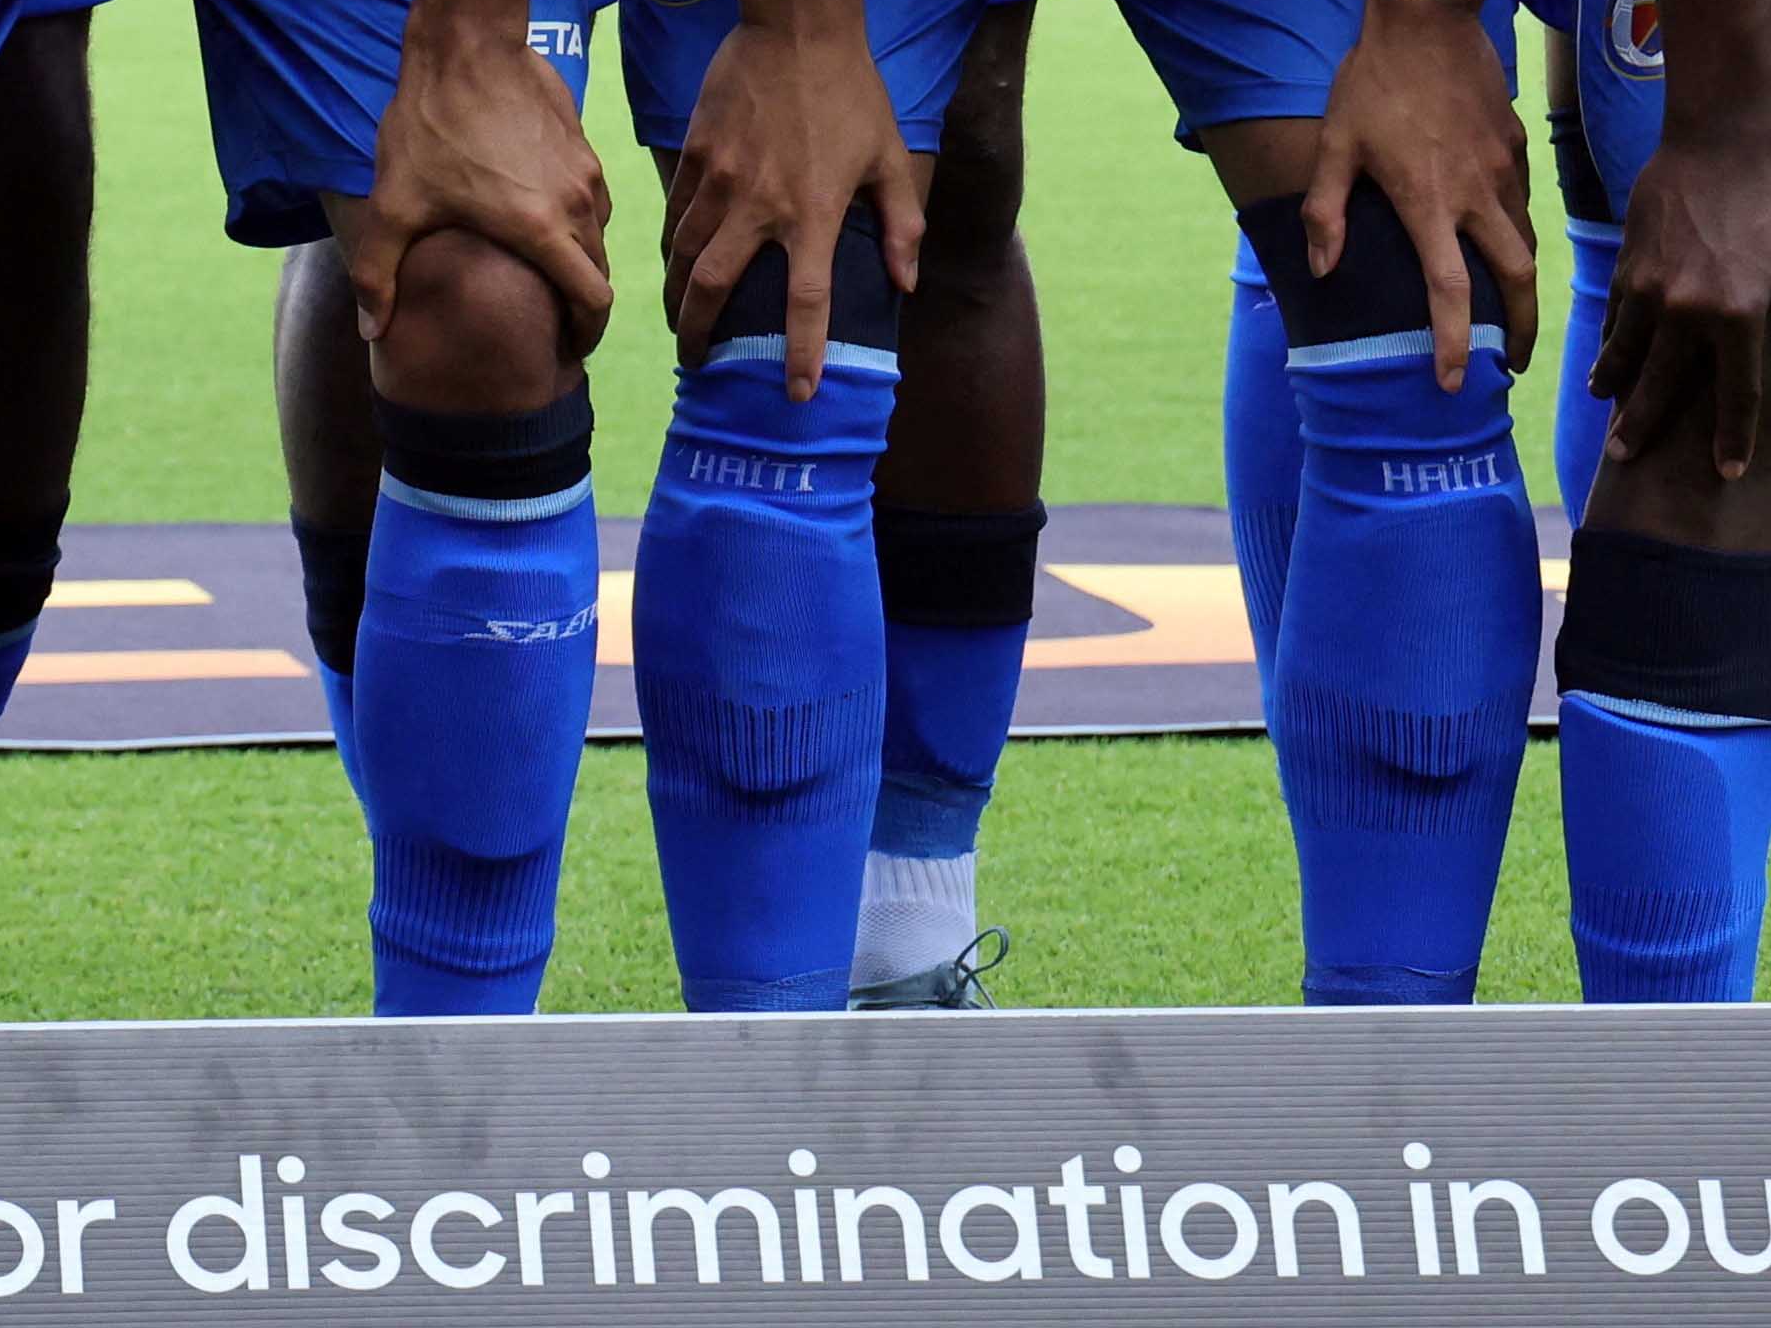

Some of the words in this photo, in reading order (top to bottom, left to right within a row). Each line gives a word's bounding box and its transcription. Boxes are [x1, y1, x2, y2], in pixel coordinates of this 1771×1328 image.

[526, 20, 583, 60] ETA
[166, 1146, 1364, 1289] discrimination
[1402, 1141, 1546, 1278] in
